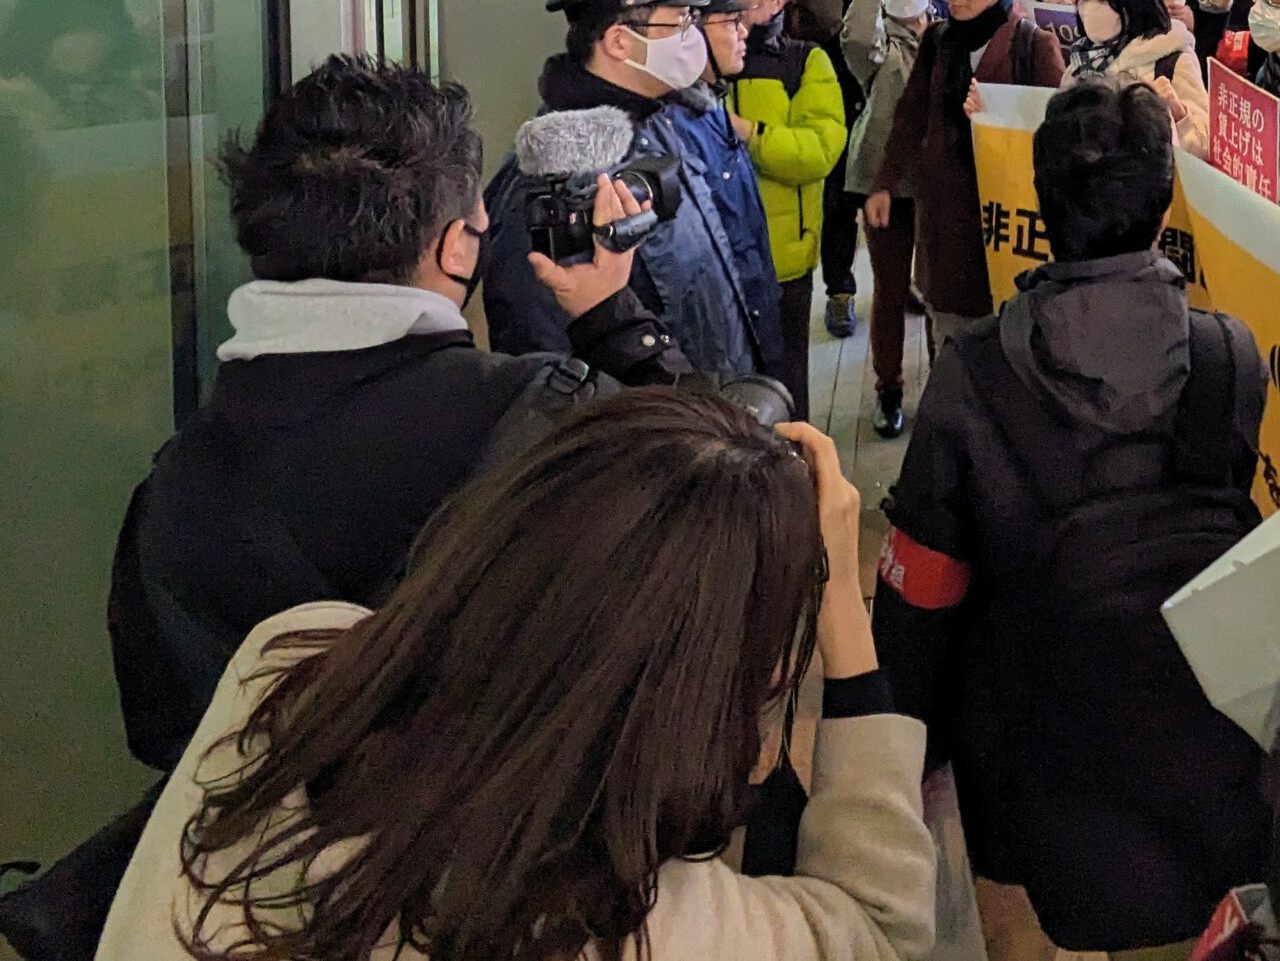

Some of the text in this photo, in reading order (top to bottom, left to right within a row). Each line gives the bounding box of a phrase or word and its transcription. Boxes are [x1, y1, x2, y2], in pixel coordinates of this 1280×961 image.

[1218, 82, 1265, 133] 非正規の
[1213, 135, 1272, 198] 社会的責任
[1218, 111, 1264, 167] 賃上げは
